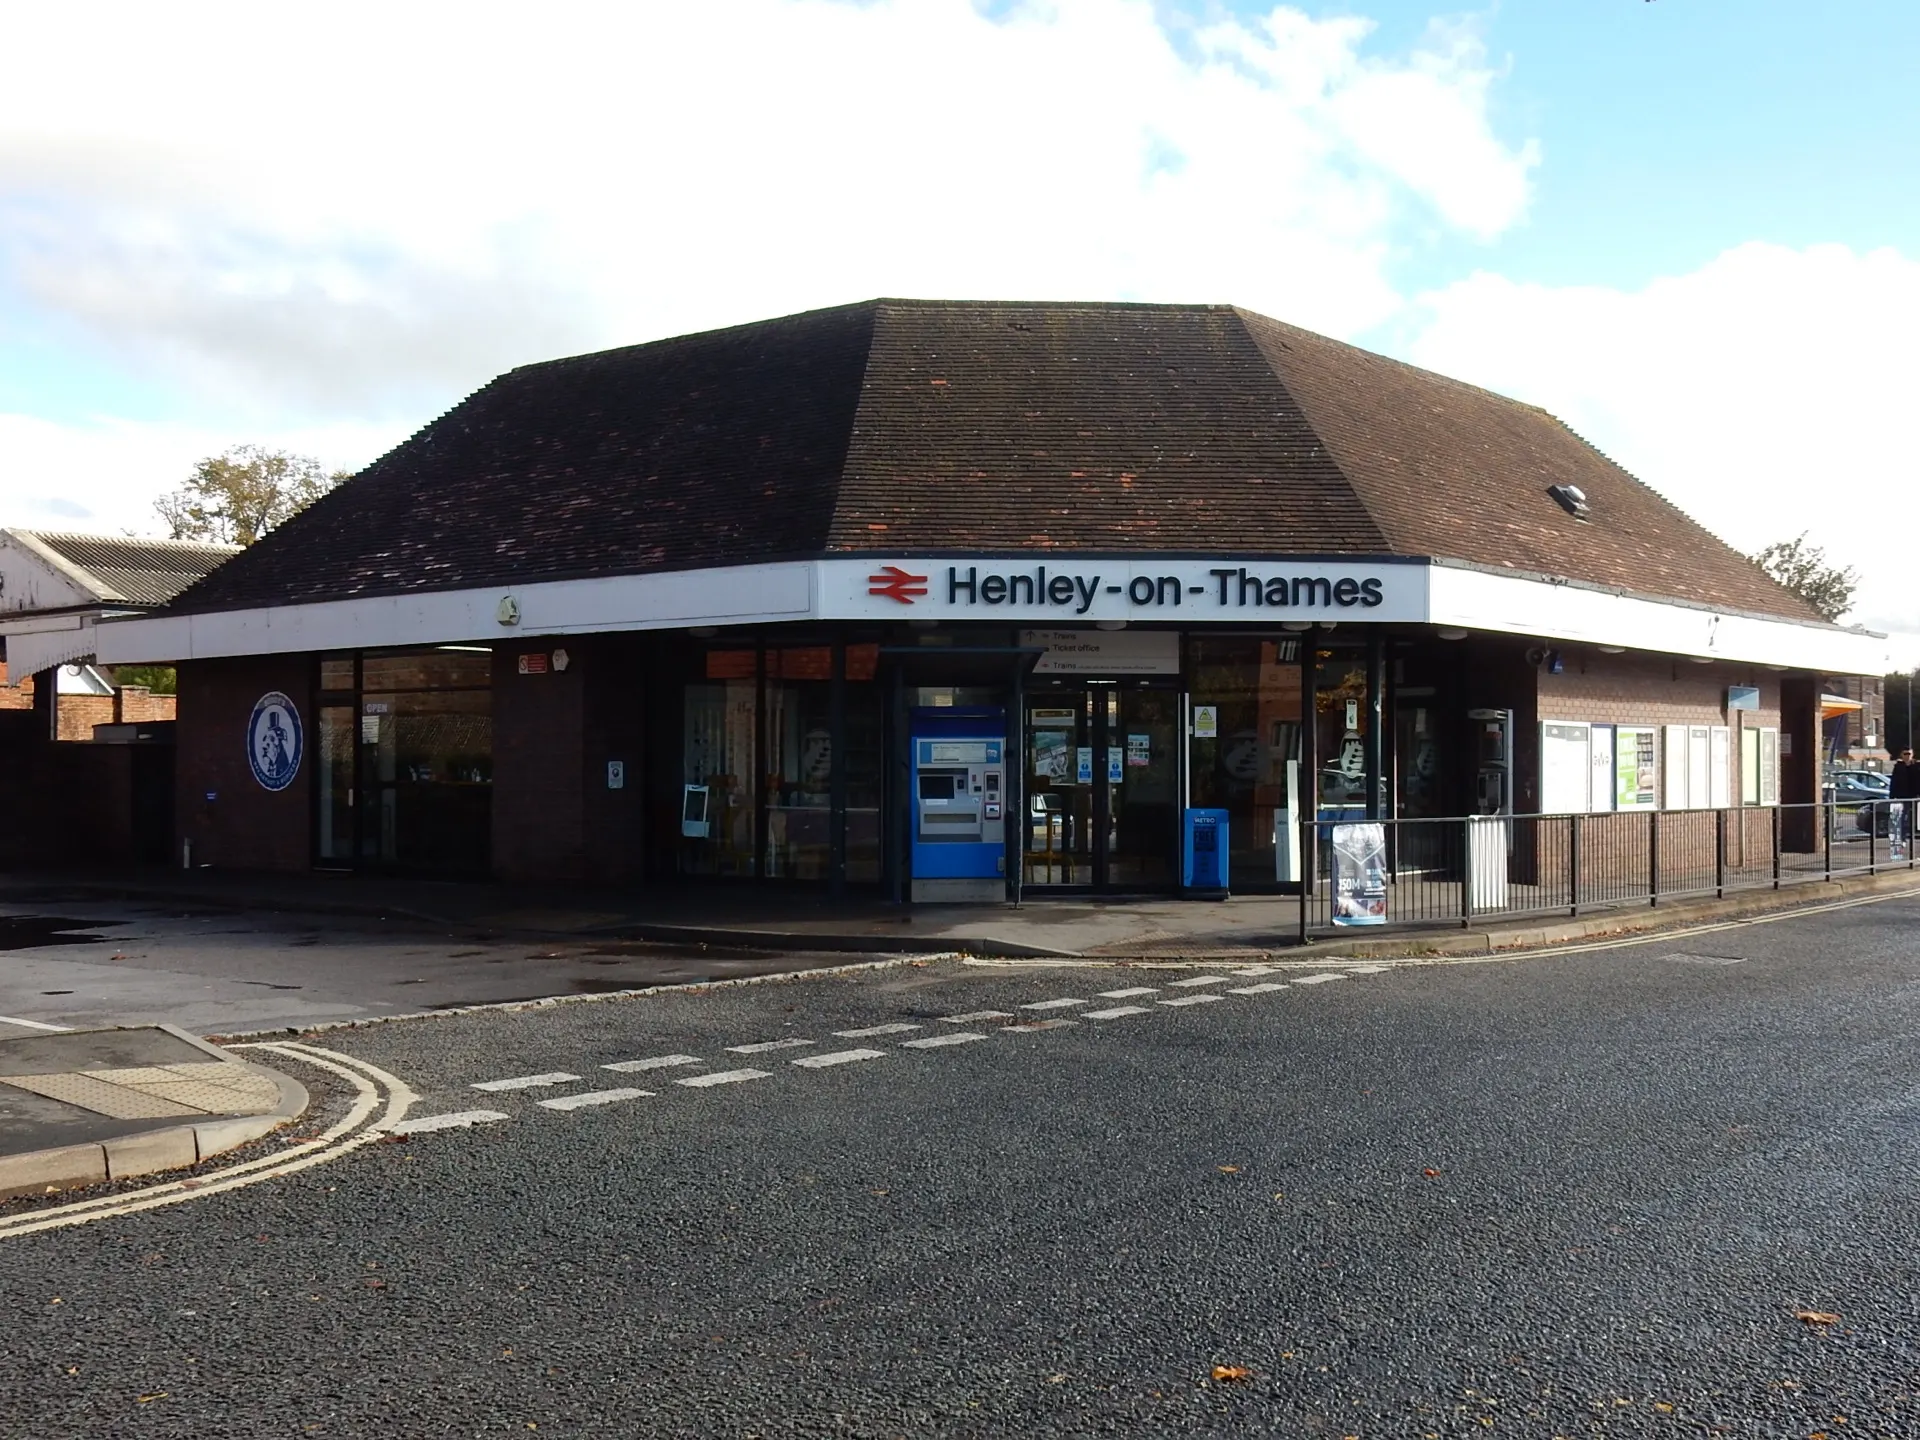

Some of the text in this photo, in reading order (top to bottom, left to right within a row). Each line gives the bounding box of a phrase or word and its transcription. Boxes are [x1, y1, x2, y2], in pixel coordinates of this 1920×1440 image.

[947, 566, 1384, 614] Henley-on-Thames
[1053, 632, 1076, 640] Trains
[1053, 644, 1100, 652] Ticket office
